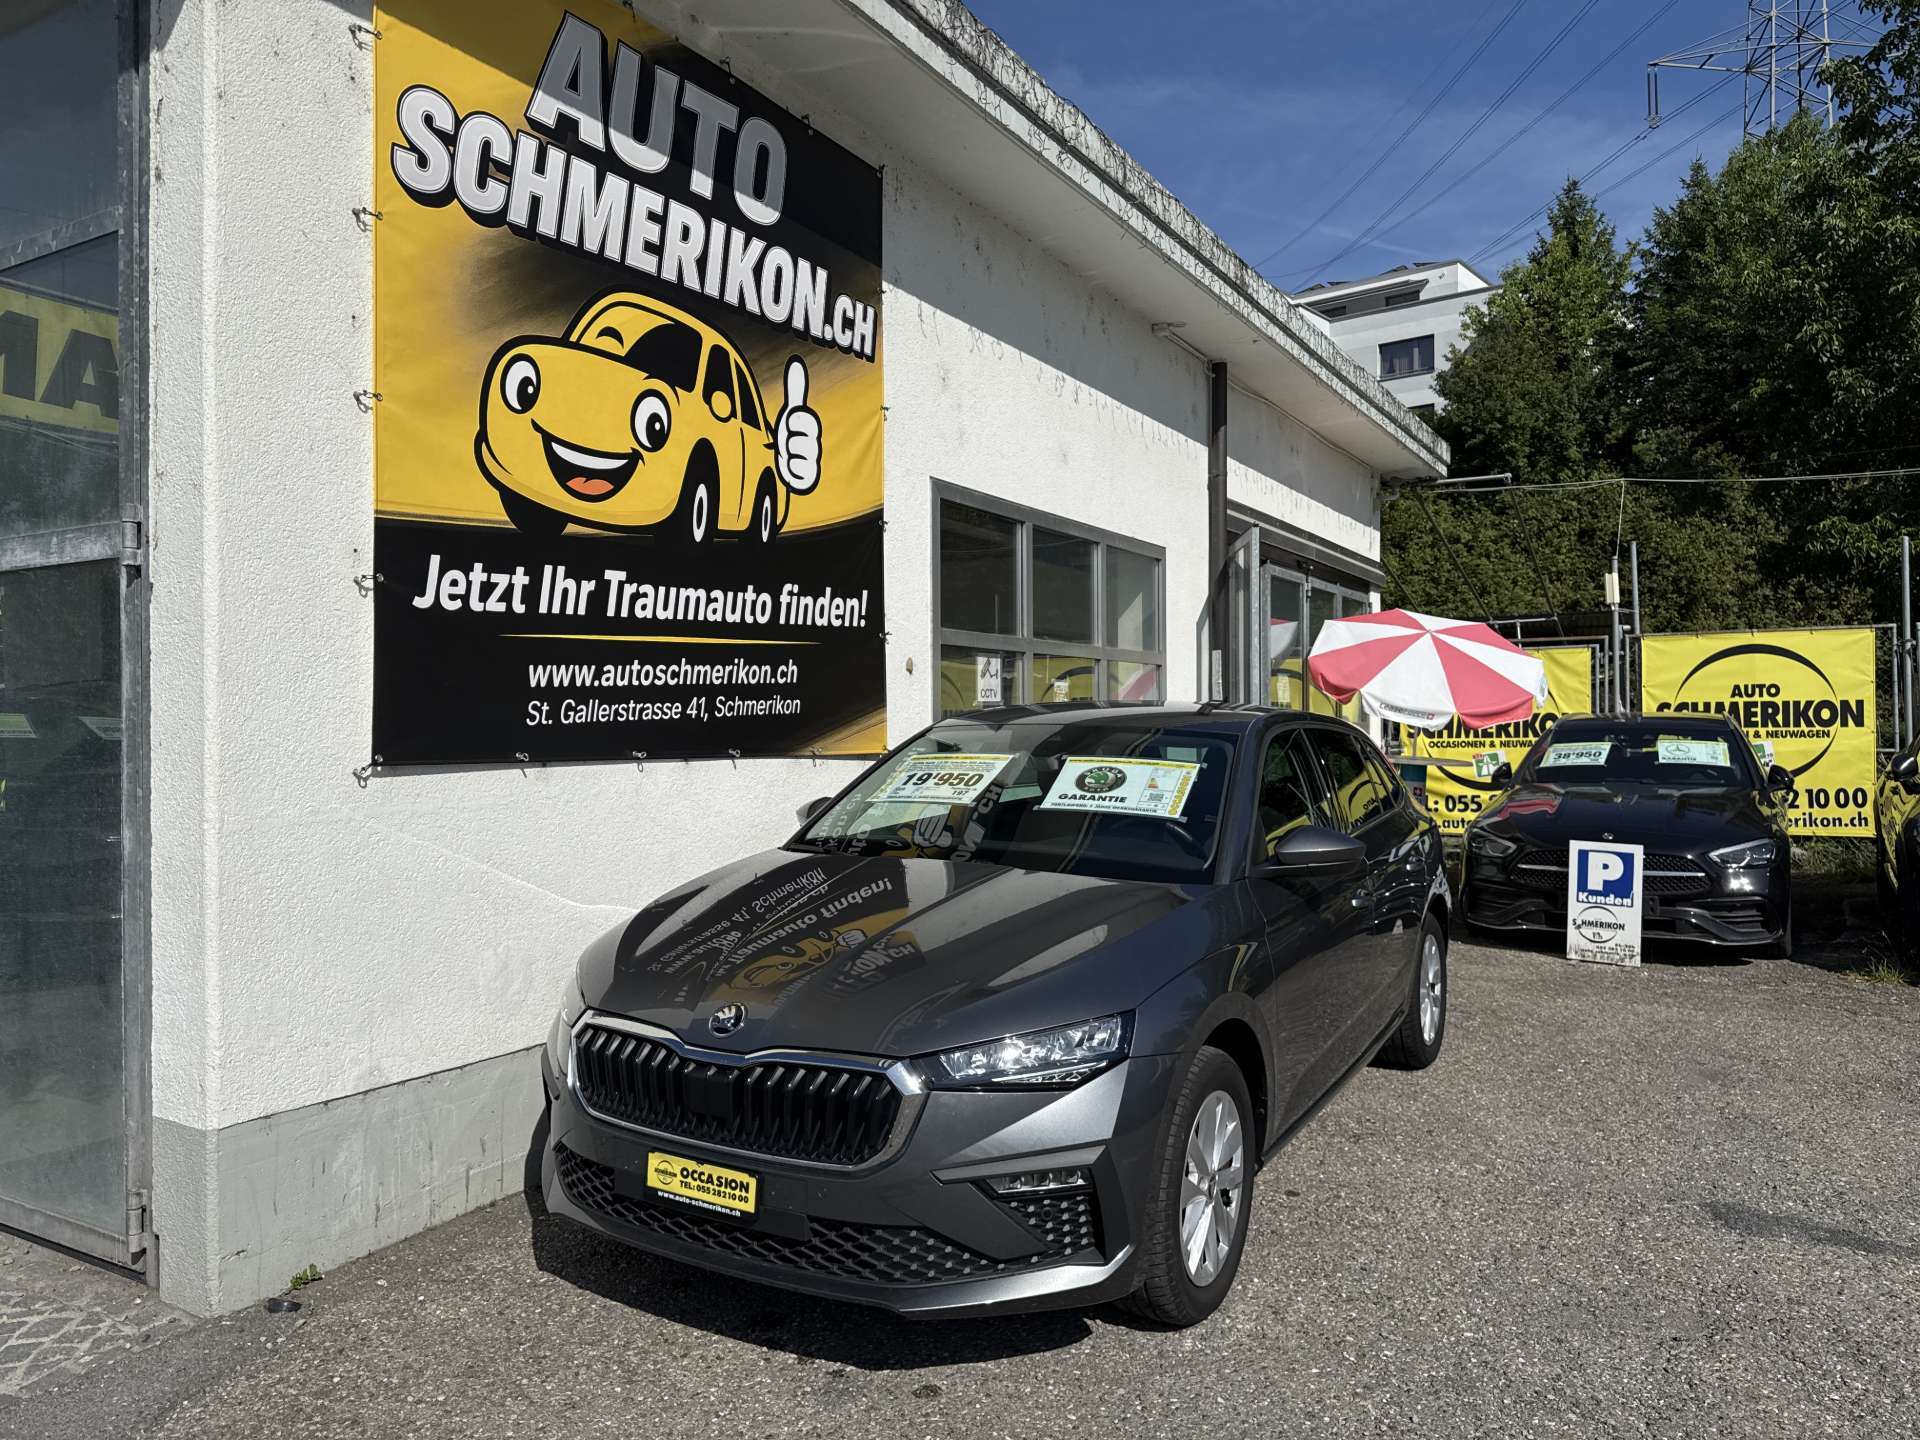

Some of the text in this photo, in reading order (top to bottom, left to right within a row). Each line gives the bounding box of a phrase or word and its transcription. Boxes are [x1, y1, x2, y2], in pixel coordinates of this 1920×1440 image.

[526, 11, 788, 227] AUTO
[391, 86, 877, 362] SCHMERIKON.CH
[412, 554, 869, 628] Jetzt Ihr Traumauto finden!
[528, 658, 799, 688] www.autoschmerikon.ch
[1730, 683, 1781, 698] AUTO
[526, 695, 801, 727] St. Gallerstrasse 41, Schmerikon
[1753, 730, 1761, 738] &
[1765, 729, 1831, 739] NEUWAGEN
[1428, 740, 1486, 749] OCCASIONEN
[1489, 740, 1496, 748] &
[1553, 750, 1602, 761] 38'950
[901, 772, 984, 787] 19'950
[1058, 793, 1128, 803] GARANTIE
[1444, 794, 1483, 812] 055
[1805, 788, 1830, 808] 10
[1834, 787, 1868, 808] 00
[1588, 852, 1624, 891] P
[1579, 892, 1632, 907] Kunden
[1572, 918, 1626, 931] SHMERIKON
[680, 1167, 750, 1194] OCCASION
[680, 1181, 695, 1190] TEL:
[697, 1185, 711, 1194] 055
[712, 1188, 727, 1199] 282
[658, 1190, 742, 1217] www.auto-schmerikon.ch
